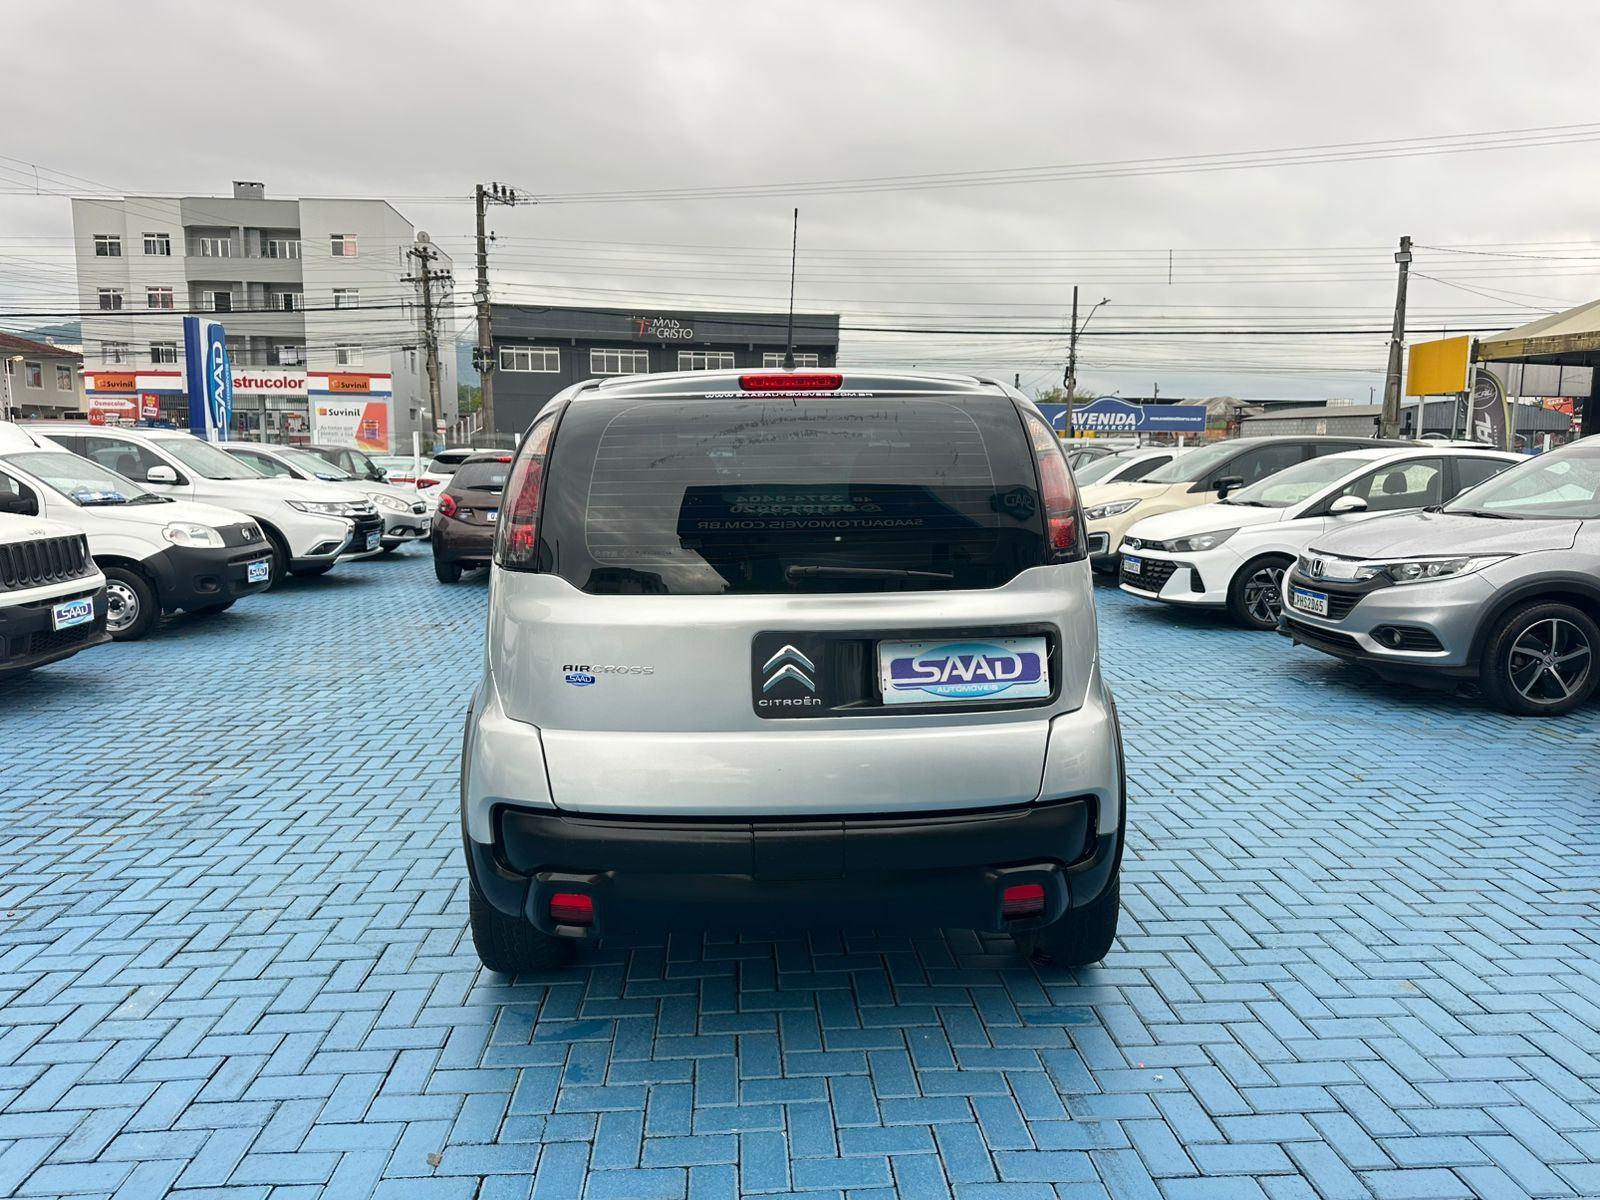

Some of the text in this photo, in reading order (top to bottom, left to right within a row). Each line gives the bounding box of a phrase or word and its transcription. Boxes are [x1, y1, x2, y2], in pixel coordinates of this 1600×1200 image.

[652, 318, 680, 329] MAIS
[656, 327, 693, 339] CRISTO
[106, 380, 133, 388] Suvinil
[233, 376, 305, 389] strucolor
[340, 381, 368, 389] Suvinil
[212, 341, 228, 441] SAAD
[328, 407, 361, 417] Suvinil
[1072, 412, 1136, 426] AVENIDA
[61, 604, 89, 618] SAAD
[911, 653, 1023, 683] SAAD
[569, 675, 592, 683] SAAD
